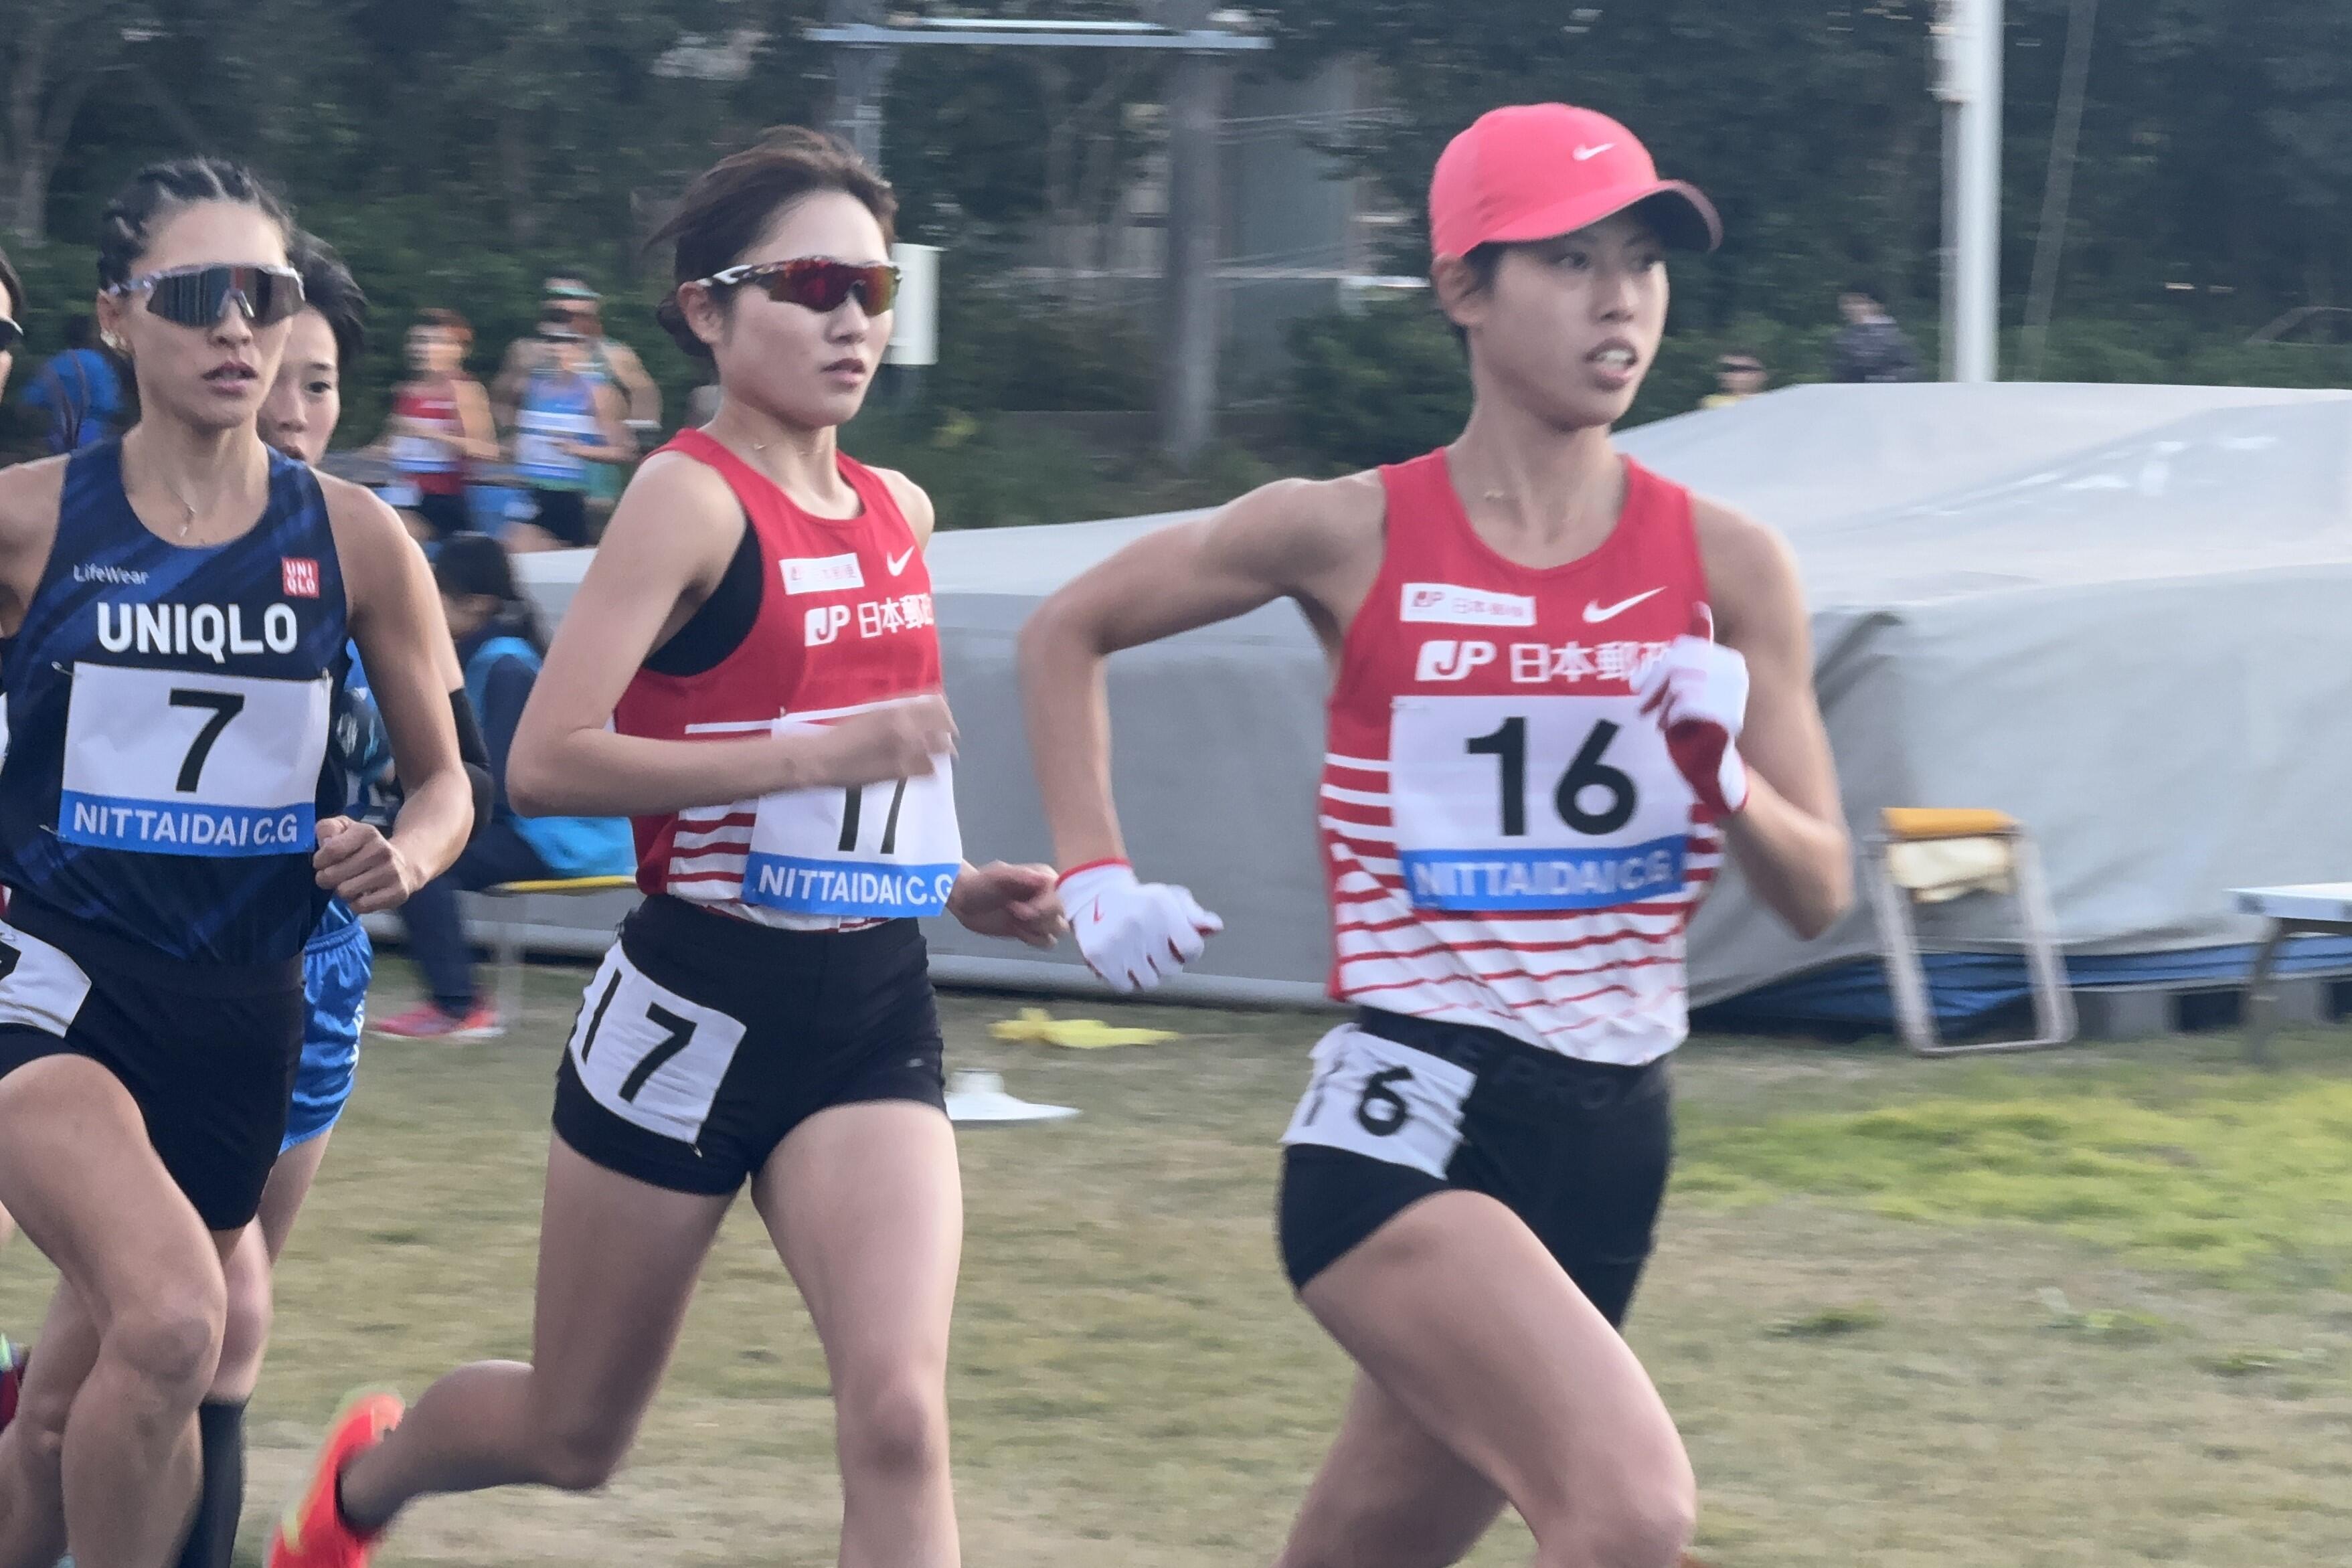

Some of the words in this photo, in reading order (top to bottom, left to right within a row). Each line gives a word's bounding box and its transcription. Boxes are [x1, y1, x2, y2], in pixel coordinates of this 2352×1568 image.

[73, 562, 150, 585] LifeWear
[286, 560, 313, 578] UNI
[286, 577, 316, 594] QLO
[97, 602, 298, 663] UNIQLO
[805, 605, 851, 647] JP
[1414, 640, 1497, 681] JP
[169, 687, 245, 793] 7
[1465, 716, 1639, 837] 16
[581, 967, 697, 1104] 17
